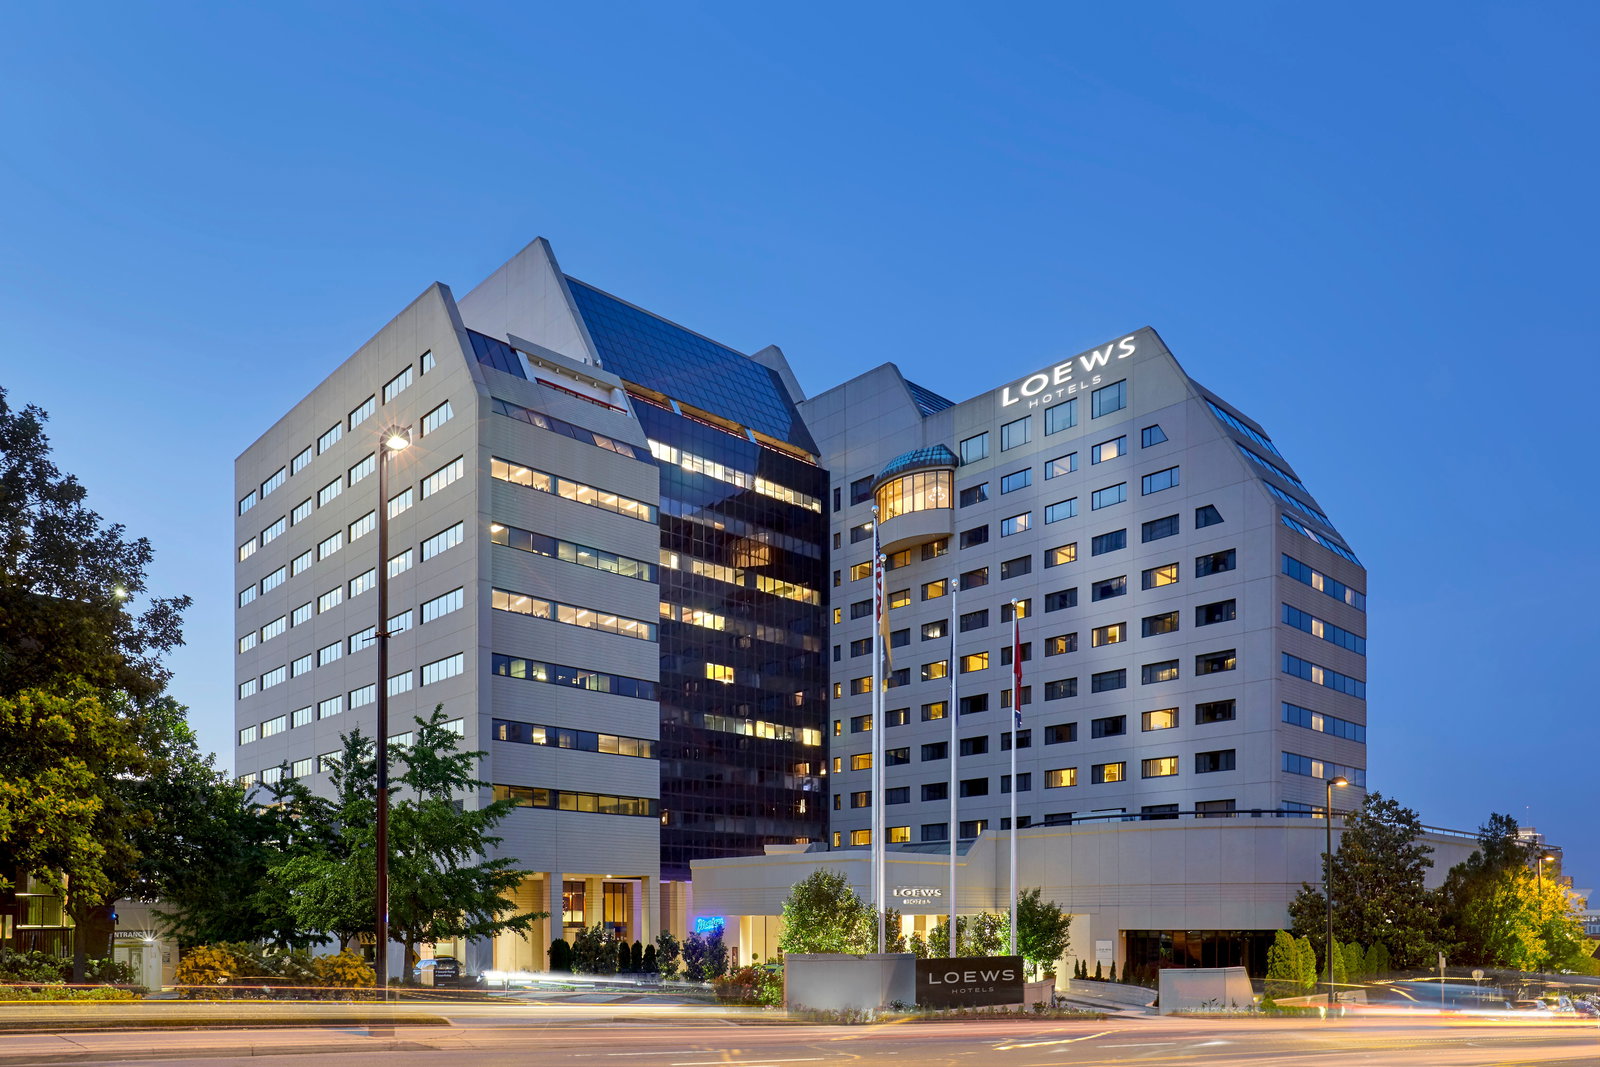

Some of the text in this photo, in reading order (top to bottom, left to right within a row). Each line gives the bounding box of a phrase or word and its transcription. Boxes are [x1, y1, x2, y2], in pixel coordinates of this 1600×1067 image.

[1002, 336, 1136, 407] LOEWS
[1029, 375, 1102, 409] HOTELS
[893, 888, 942, 898] LOEWS
[928, 969, 1015, 985] LOEWS
[951, 986, 994, 994] HOTELS
